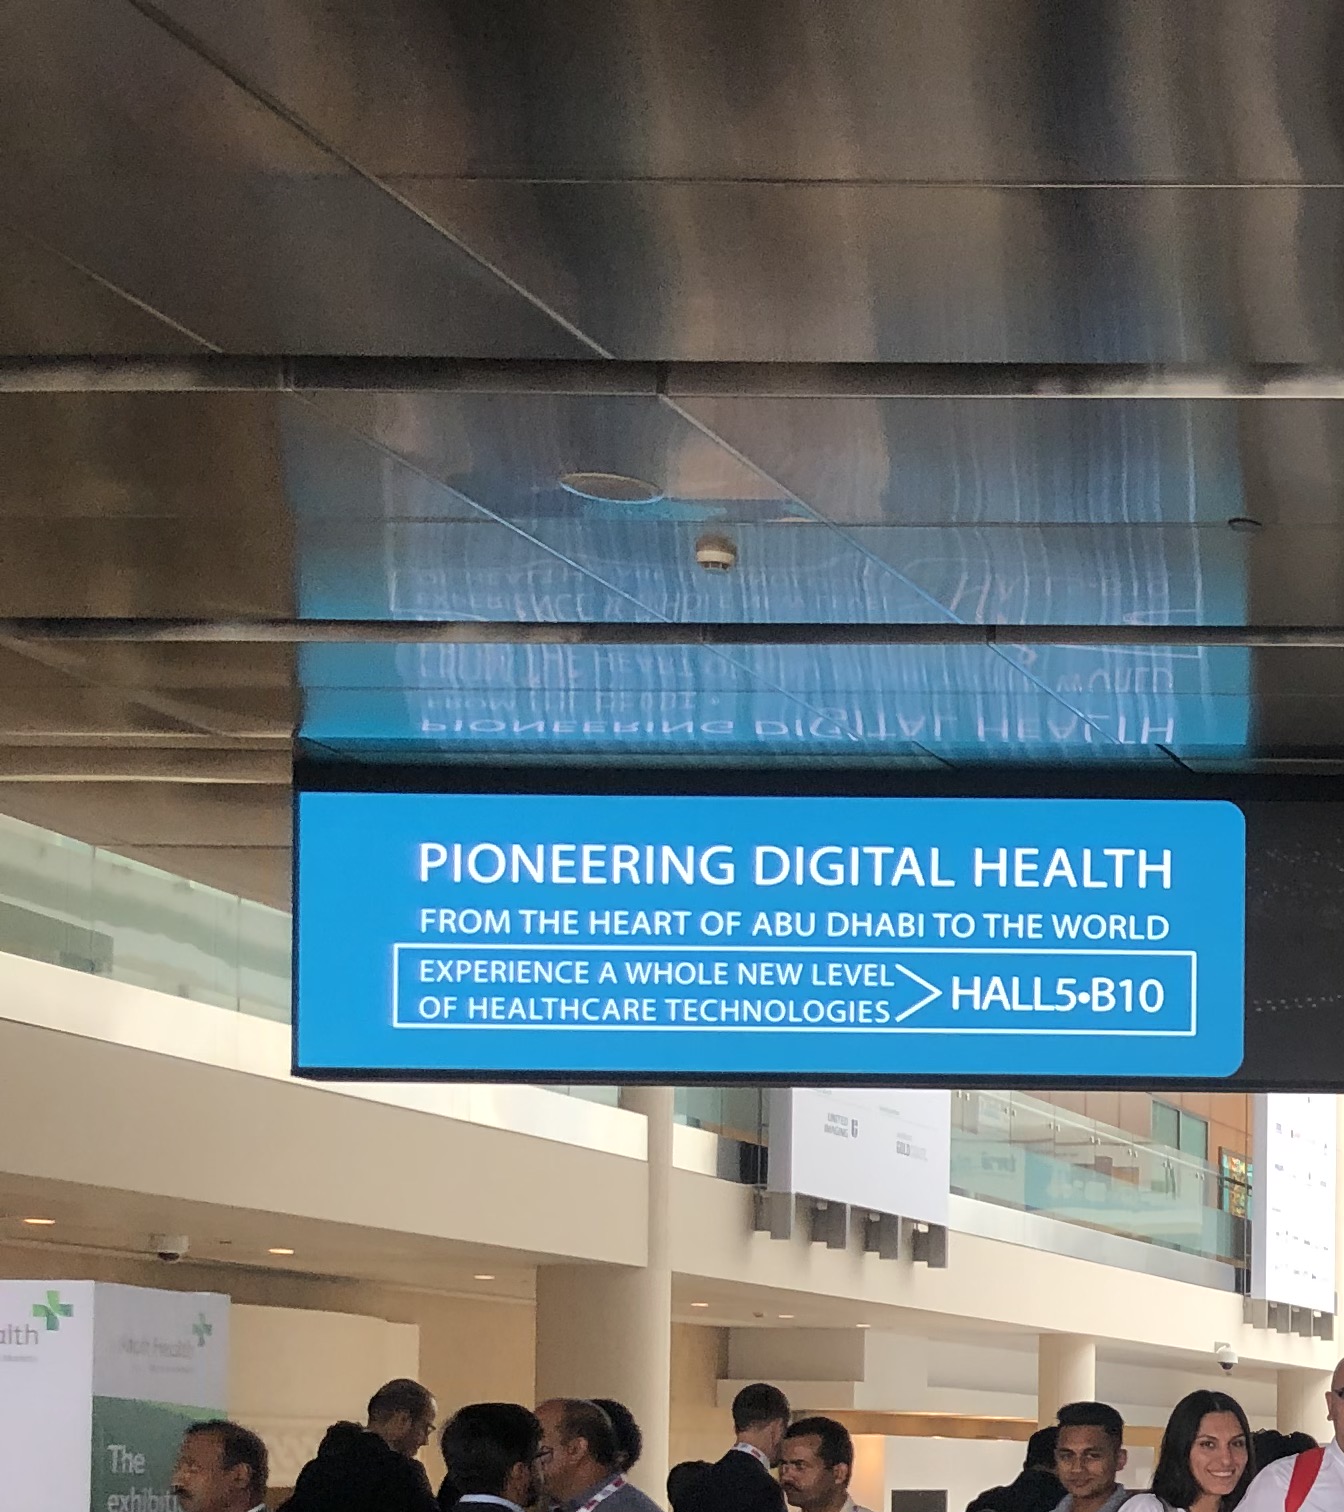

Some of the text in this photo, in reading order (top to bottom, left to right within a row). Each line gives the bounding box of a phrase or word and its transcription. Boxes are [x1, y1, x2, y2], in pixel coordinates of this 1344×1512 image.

[419, 842, 1172, 889] PIONEERING DIGITAL HEALTH
[420, 908, 1170, 941] FROM THE HEART OF ABU DHABI TO THE WORLD
[419, 959, 895, 988] EXPERIENCE A WHOLE NEW LEVEL
[418, 996, 891, 1024] OF HEALTHCARE TECHNOLOGIES
[107, 1445, 145, 1475] The
